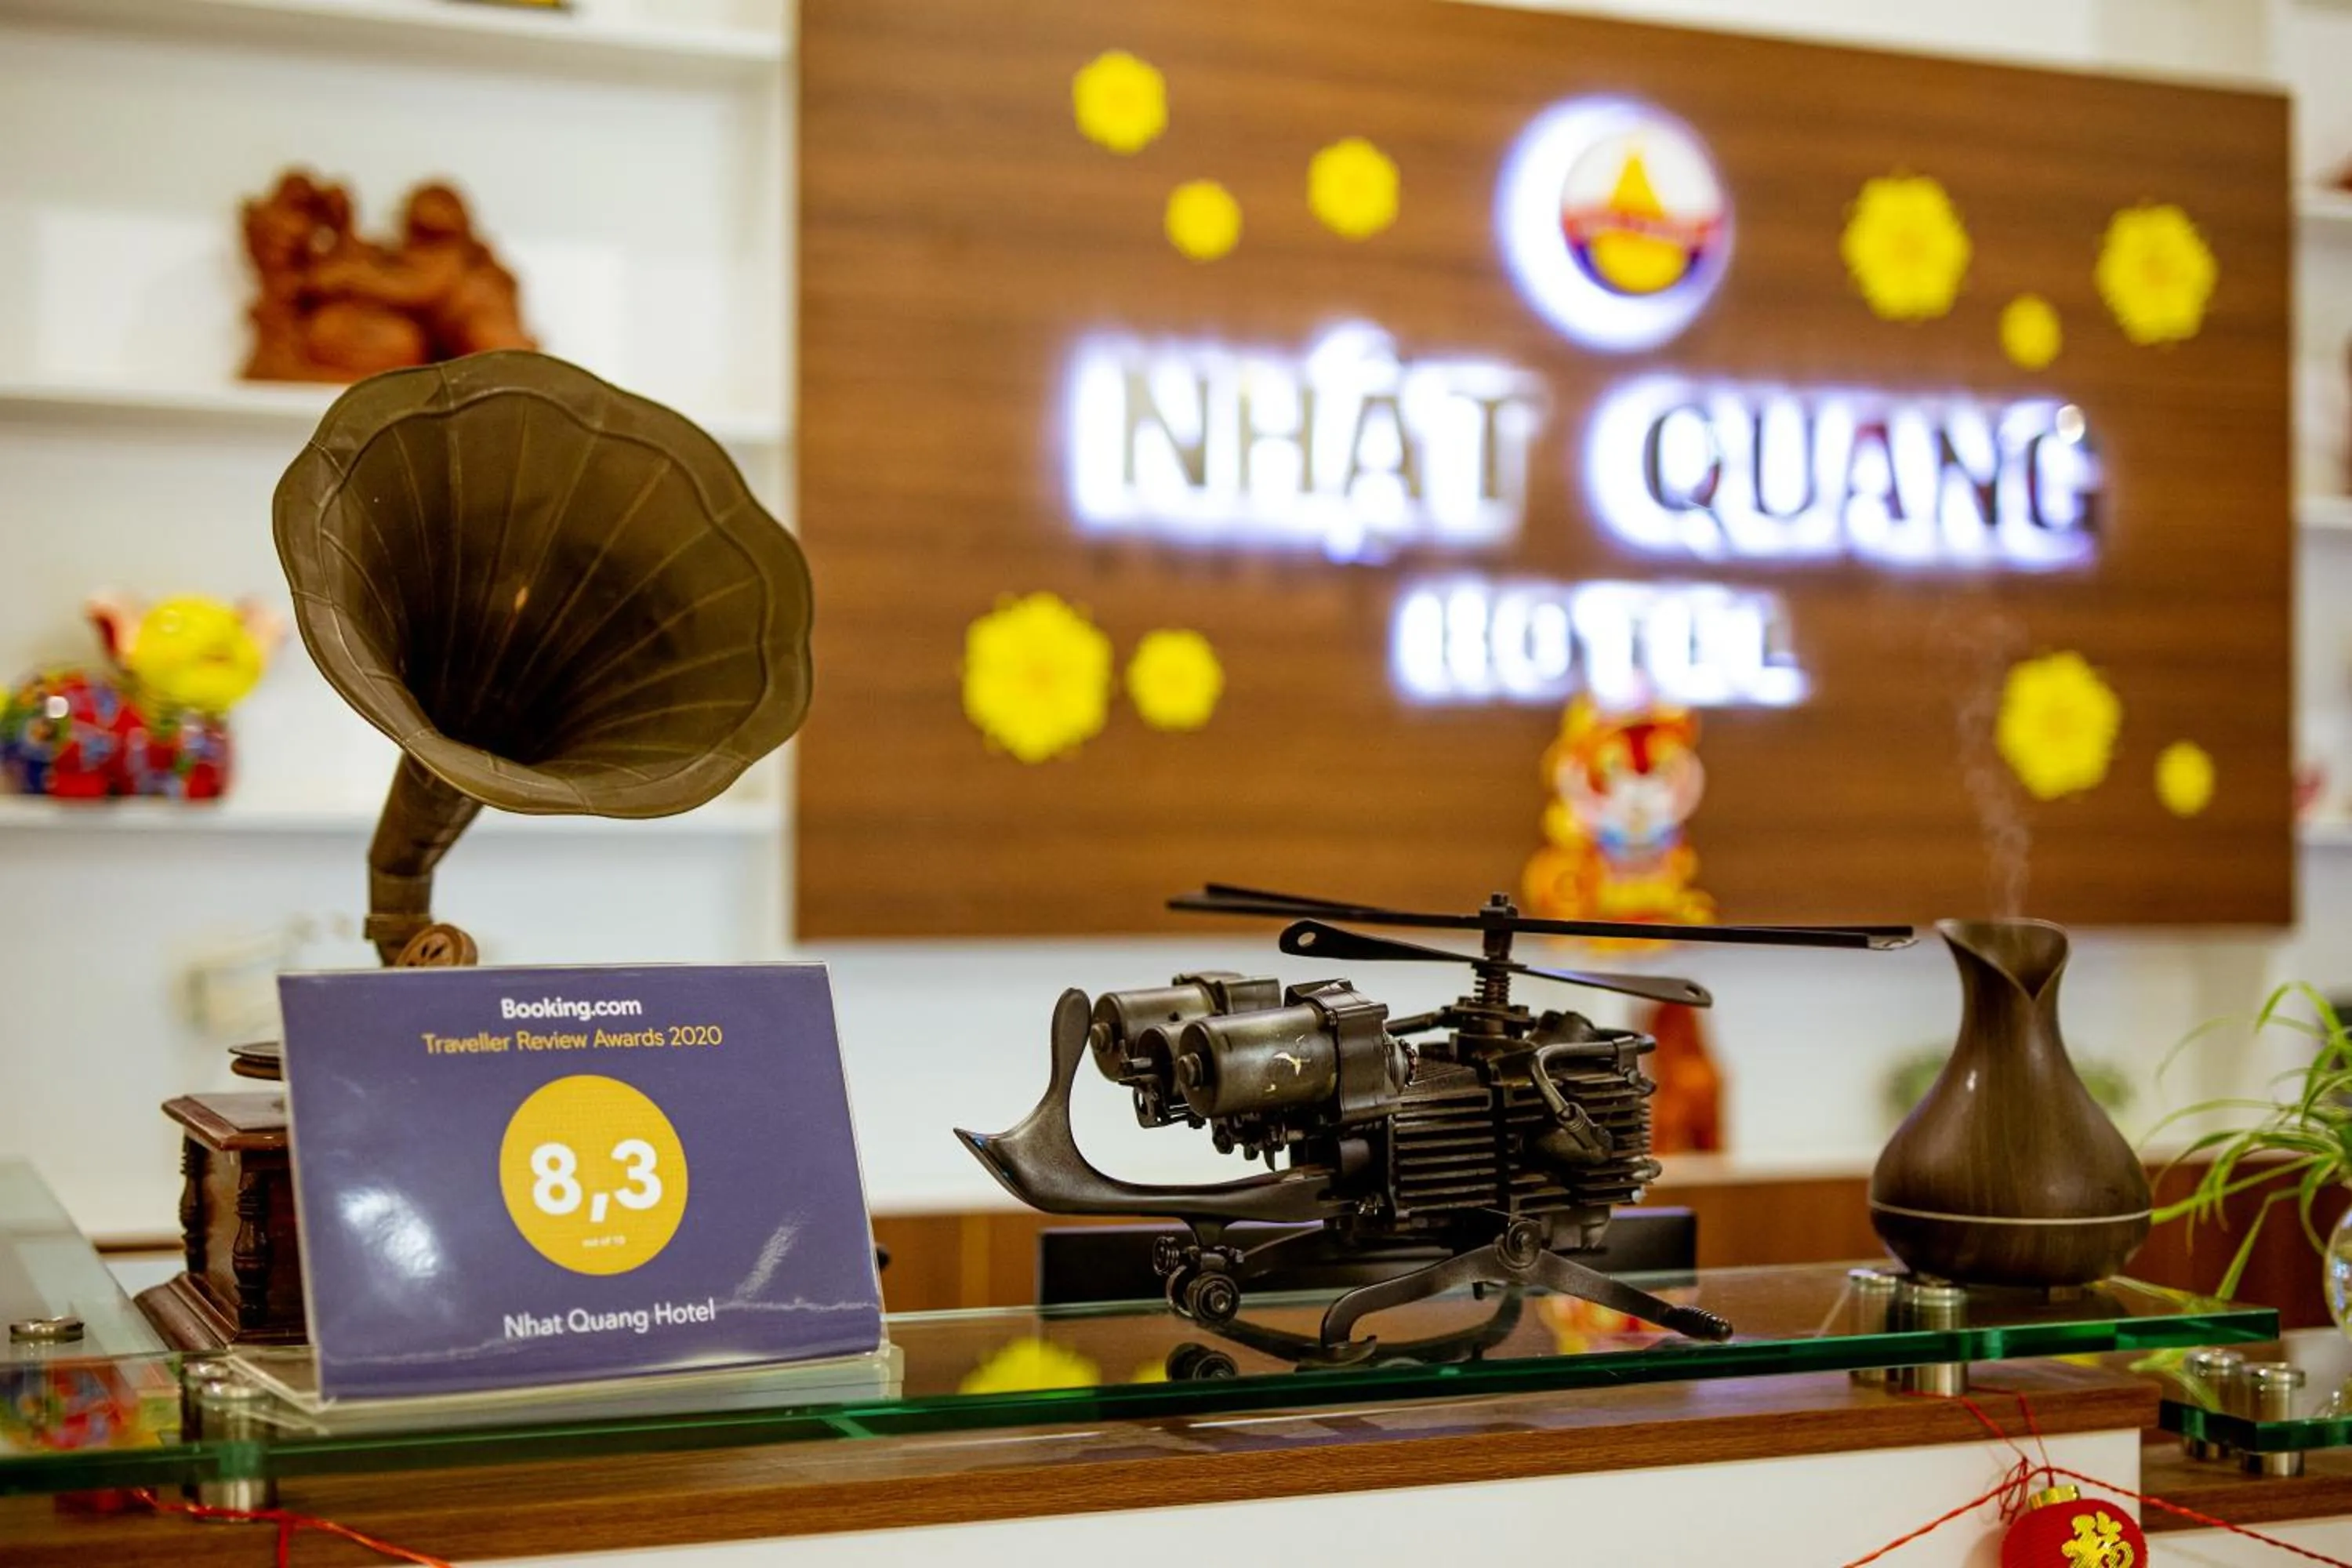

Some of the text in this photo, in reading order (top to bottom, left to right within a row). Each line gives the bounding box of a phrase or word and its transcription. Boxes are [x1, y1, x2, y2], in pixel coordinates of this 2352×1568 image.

[1588, 370, 2104, 568] QUANG
[1394, 577, 1807, 706] HOTEL
[422, 1025, 723, 1054] Traveller Review Awards 2020
[500, 997, 642, 1021] Booking.com
[530, 1138, 662, 1223] 8,3
[503, 1296, 716, 1339] Nhat Quang Hotel
